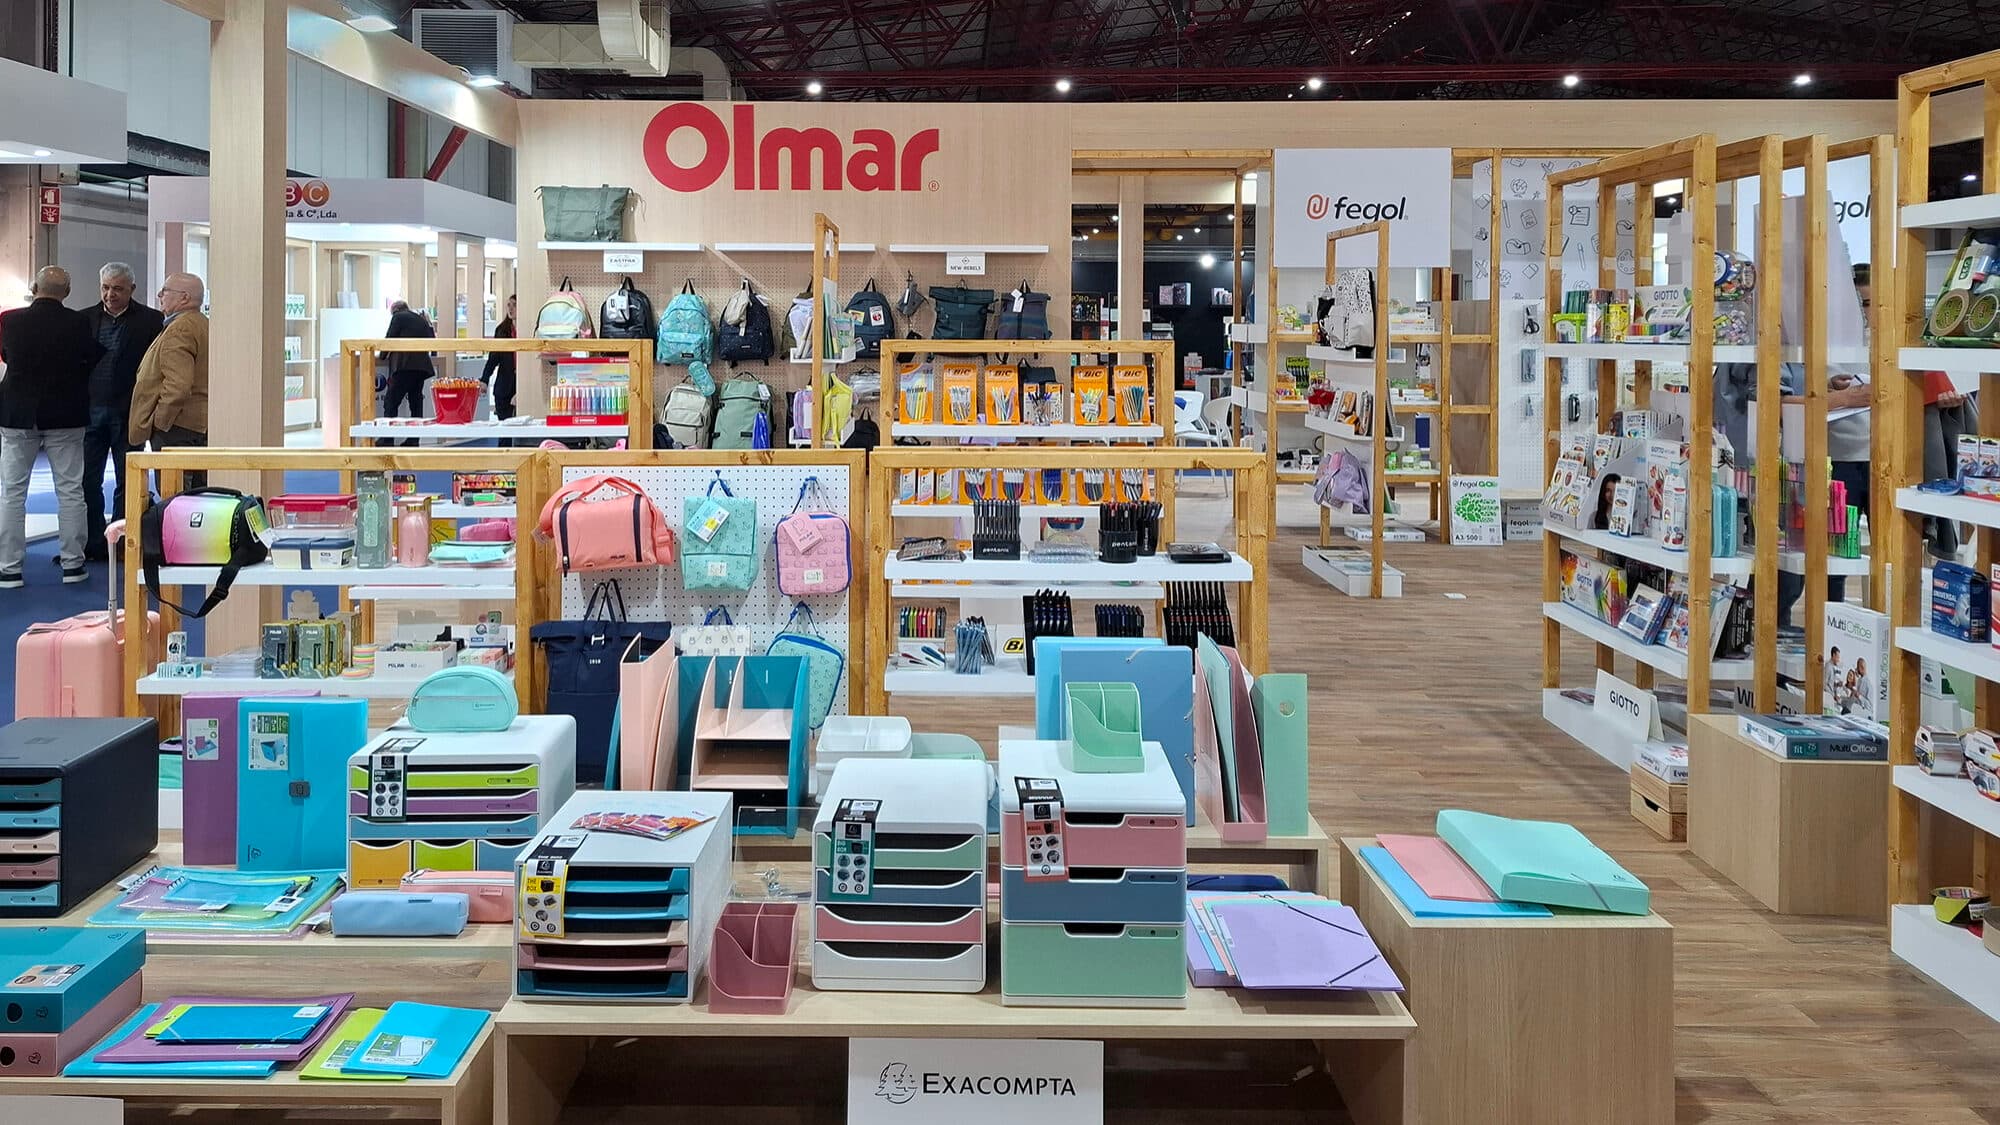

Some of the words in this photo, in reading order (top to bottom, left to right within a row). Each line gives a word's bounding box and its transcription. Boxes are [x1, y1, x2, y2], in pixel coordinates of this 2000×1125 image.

[643, 102, 939, 192] Olmar
[1334, 197, 1406, 223] fegol
[1834, 194, 1871, 223] gol
[1654, 290, 1679, 301] GIOTTO
[1609, 690, 1640, 717] GIOTTO
[922, 1072, 1076, 1097] EXACOMPTA
